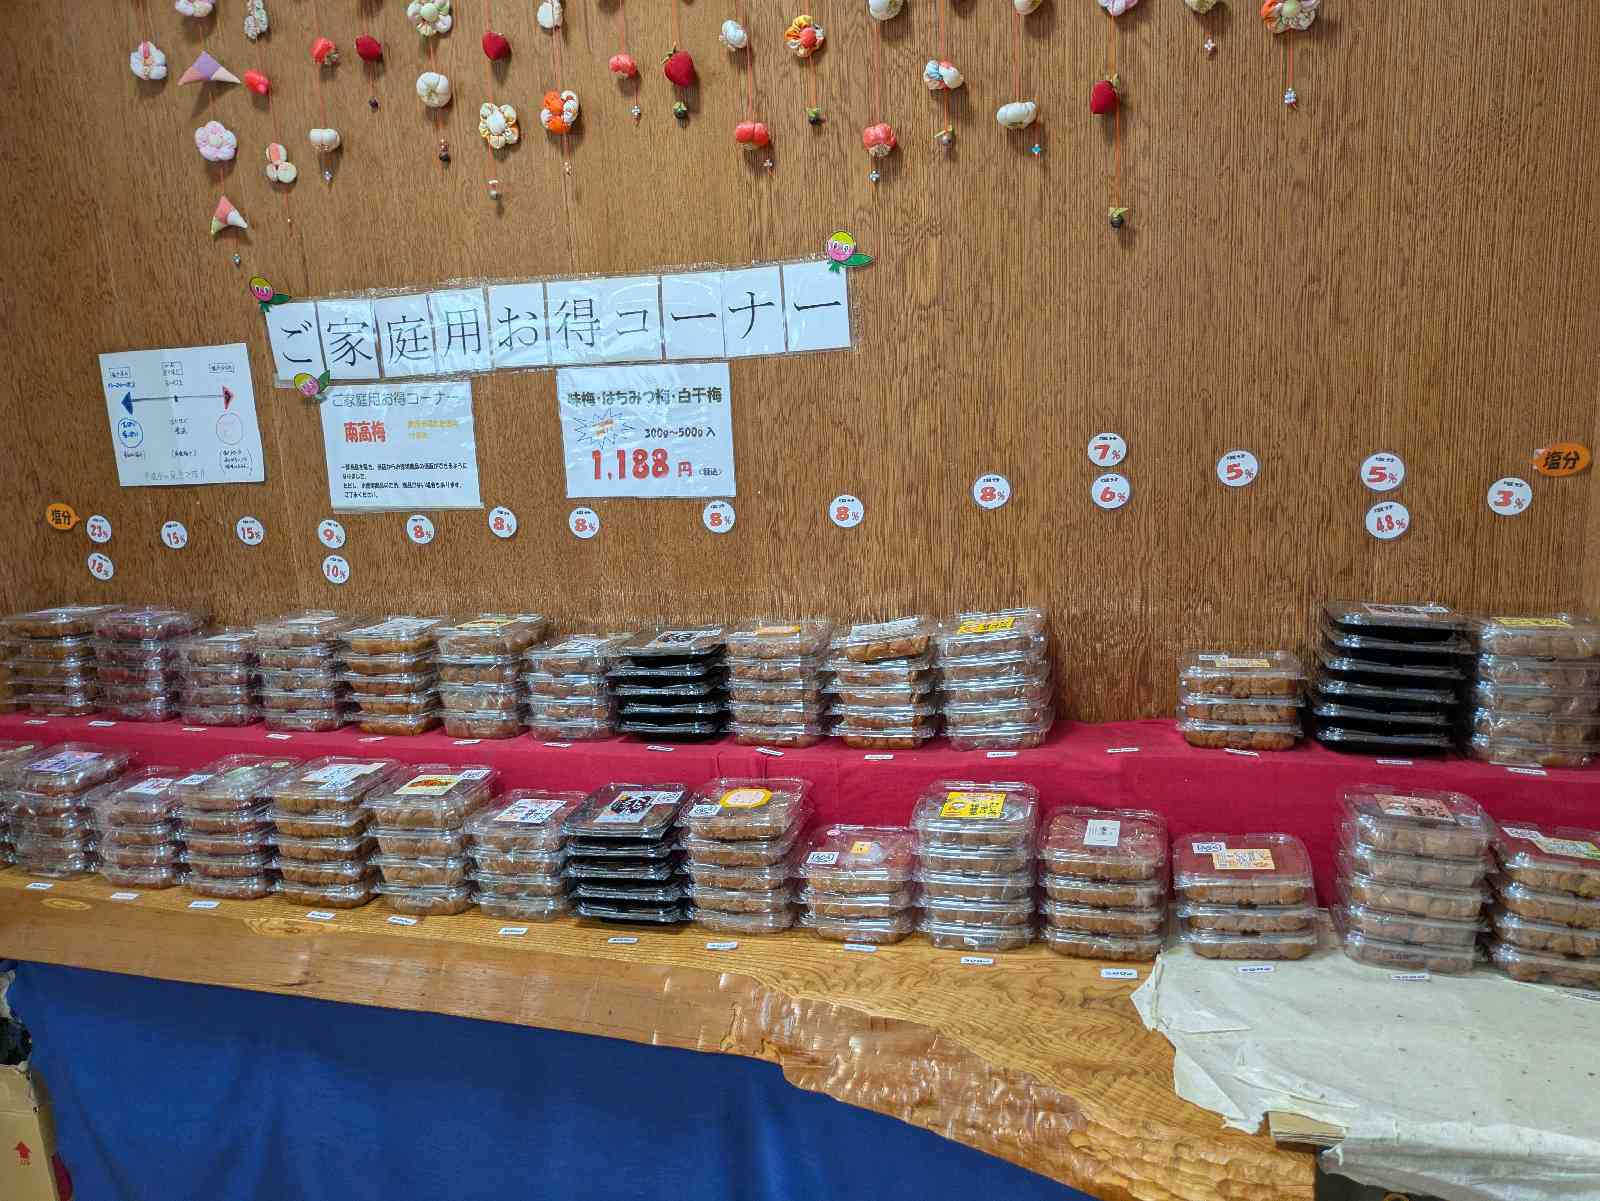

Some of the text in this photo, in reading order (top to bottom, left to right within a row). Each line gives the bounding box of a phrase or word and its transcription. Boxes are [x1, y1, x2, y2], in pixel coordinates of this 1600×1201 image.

[280, 291, 842, 366] ご家庭用お得コーナー
[332, 391, 464, 408] ご家庭用お得コーナー
[343, 420, 386, 443] 南高梅
[1094, 444, 1120, 460] 7%
[1543, 451, 1580, 470] 塩分
[677, 461, 693, 477] 円
[1225, 463, 1253, 480] 5%
[1366, 466, 1399, 484] 5%
[980, 486, 1005, 501] 8%
[1100, 486, 1126, 502] 6%
[1494, 490, 1526, 510] 3%
[709, 511, 732, 527] 8%
[835, 506, 860, 522] 8%
[412, 524, 433, 540] 8%
[493, 516, 513, 533] 8%
[574, 517, 596, 533] 8%
[323, 528, 343, 544] 9%
